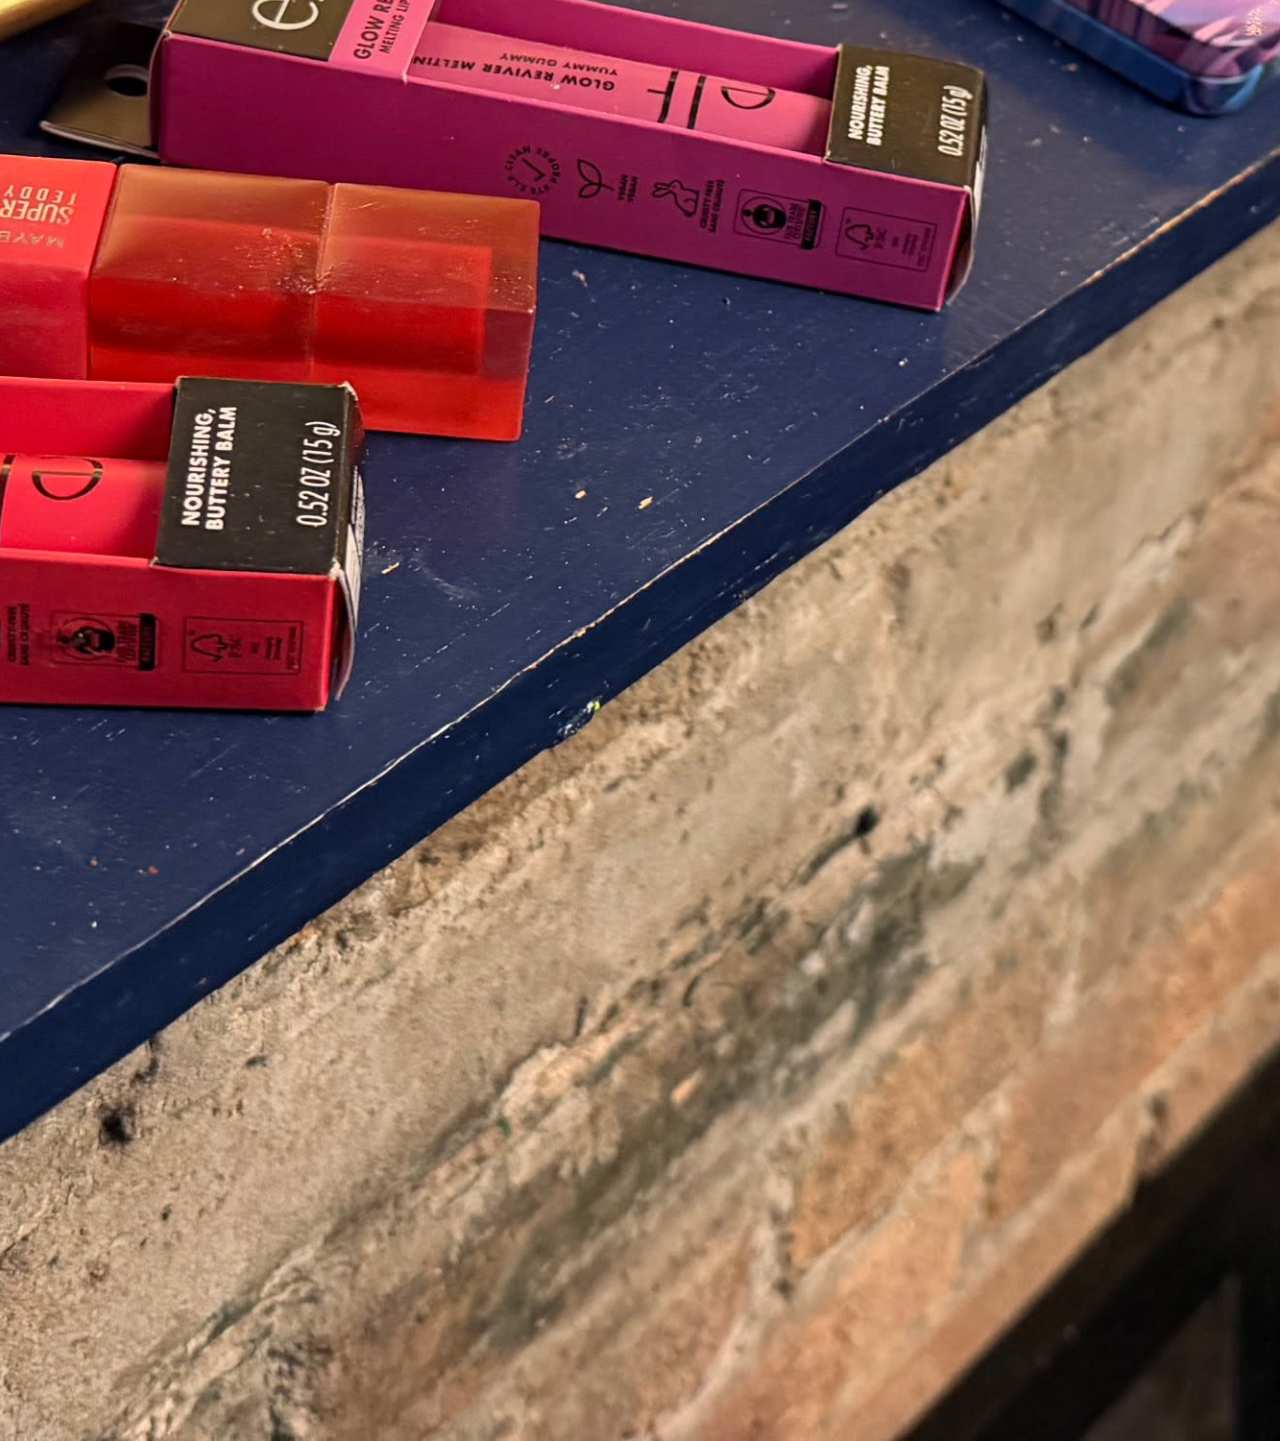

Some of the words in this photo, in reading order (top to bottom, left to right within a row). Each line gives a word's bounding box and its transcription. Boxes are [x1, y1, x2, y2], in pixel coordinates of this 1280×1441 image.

[353, 16, 384, 59] GLOW
[379, 15, 405, 54] MELTING
[396, 0, 410, 12] LIP
[411, 55, 475, 71] MELTIN
[482, 63, 554, 82] REVIVER
[500, 53, 557, 66] GUMMY
[562, 62, 618, 76] YUMMY
[560, 75, 615, 91] GLOW
[872, 65, 890, 96] BALM
[848, 65, 873, 140] NOURISHING,
[866, 97, 887, 146] BUTTERY
[937, 129, 965, 157] 0.52
[4, 185, 77, 205] TEDDY
[214, 407, 237, 451] BALM
[181, 408, 217, 526] NOURISHING,
[299, 467, 331, 488] OZ
[205, 456, 231, 530] BUTTERY
[296, 490, 330, 528] 0.52
